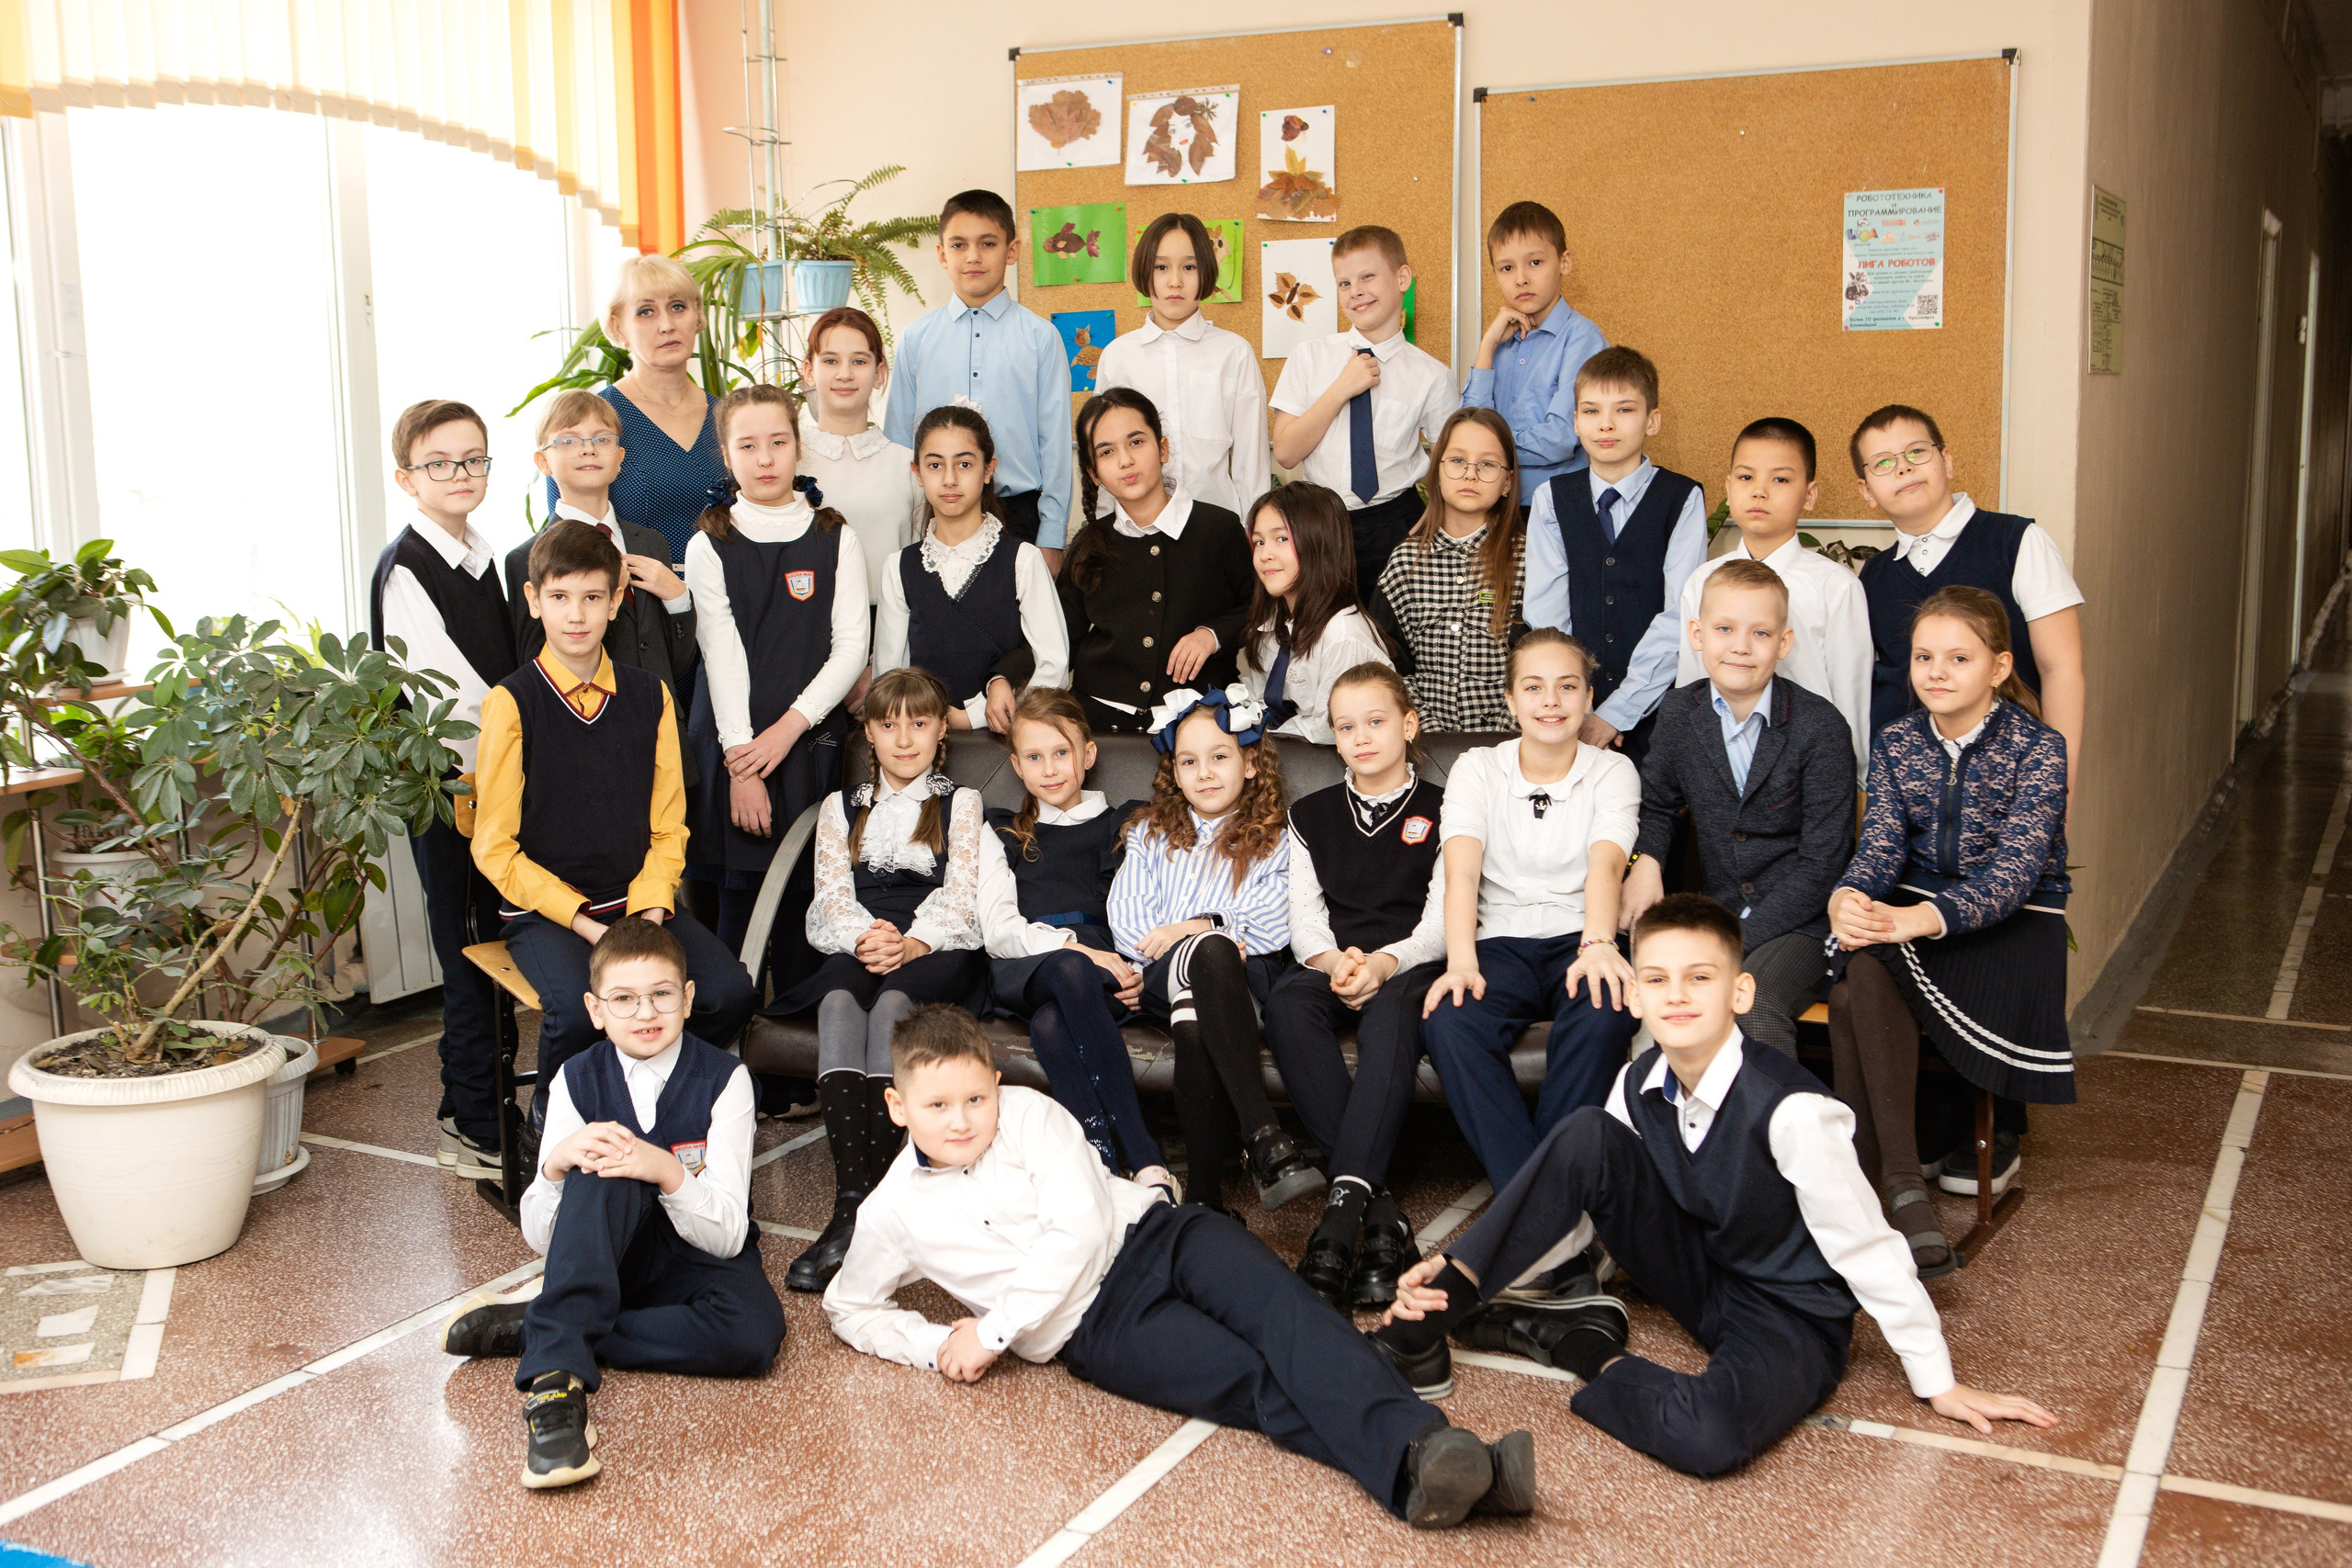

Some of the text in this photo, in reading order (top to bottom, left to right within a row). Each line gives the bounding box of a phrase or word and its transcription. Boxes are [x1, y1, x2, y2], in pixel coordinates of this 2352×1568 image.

[1856, 192, 1932, 202] РОБОТОТЕХНИКА
[1848, 206, 1941, 217] ПРОГРАММИРОВАНИЕ
[1858, 257, 1936, 269] ЛИГА РОБОТОВ
